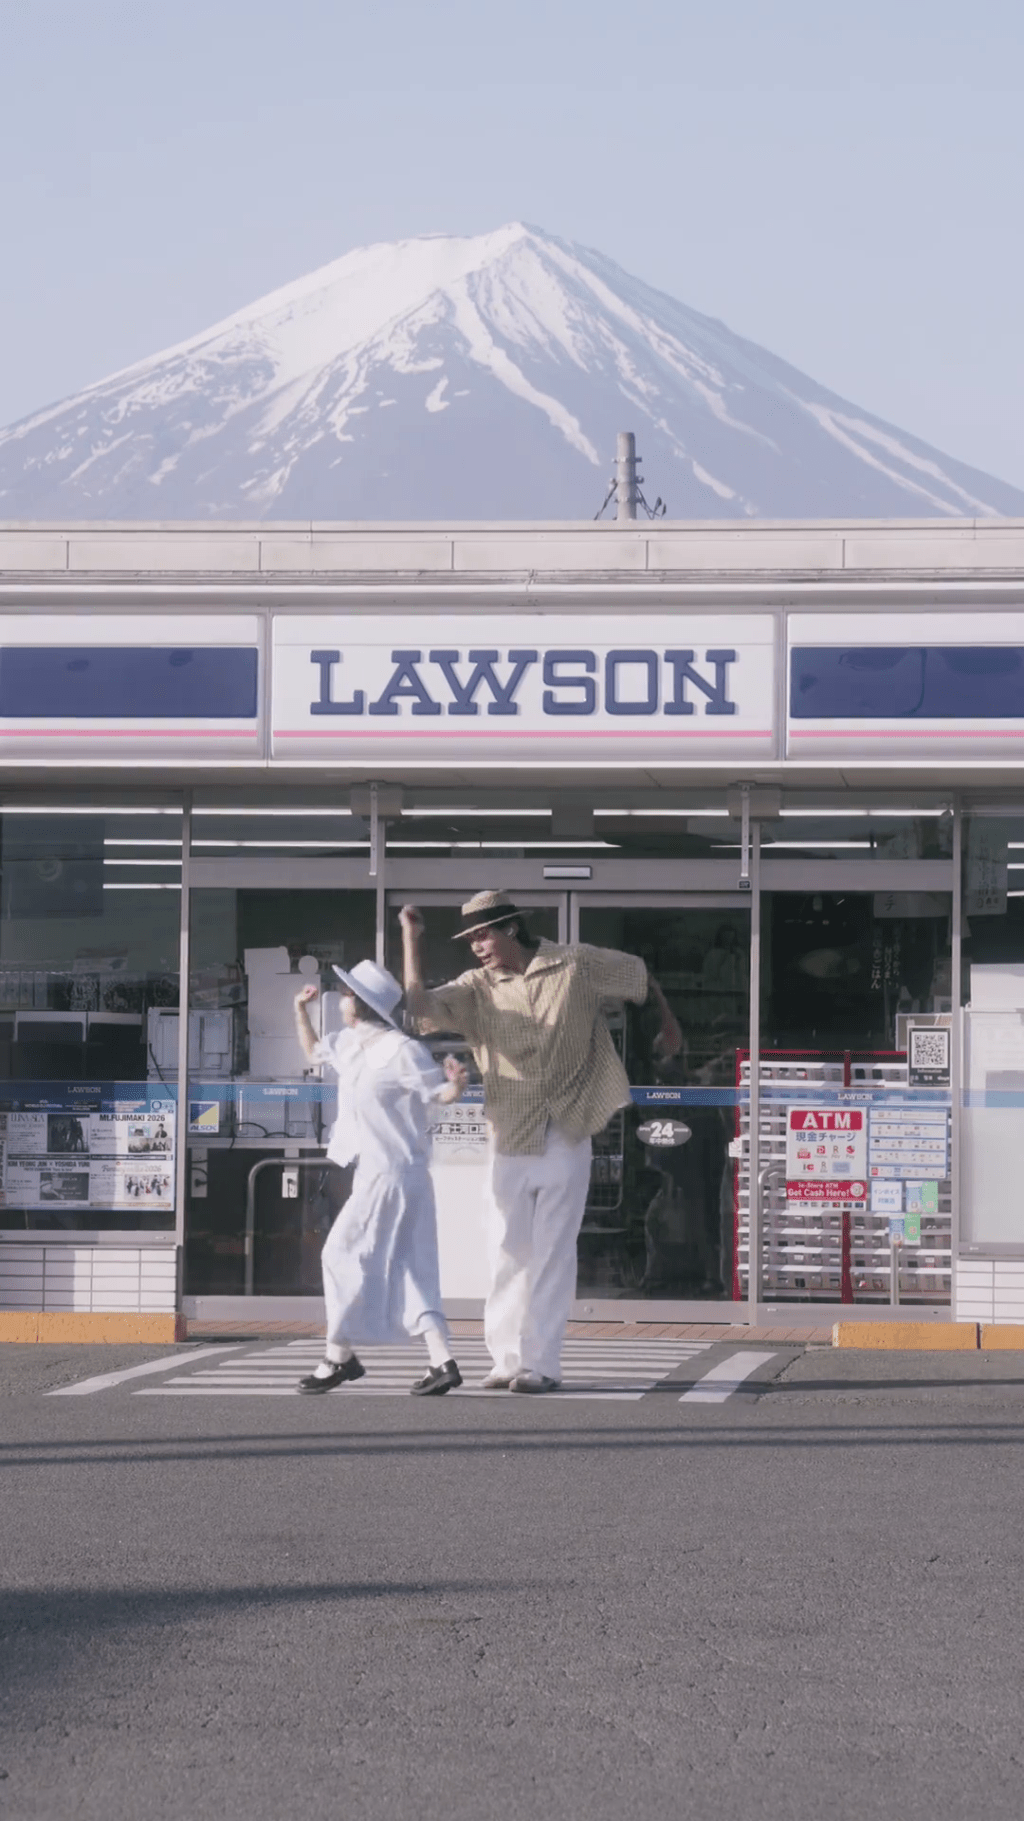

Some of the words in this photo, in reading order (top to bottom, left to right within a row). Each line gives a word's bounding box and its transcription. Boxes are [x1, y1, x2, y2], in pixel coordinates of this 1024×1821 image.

[310, 649, 736, 715] LAWSON
[67, 1086, 101, 1094] LAWSON
[263, 1088, 299, 1096] LAWSON
[837, 1093, 873, 1101] LAWSON
[147, 1114, 166, 1122] 2026
[802, 1112, 851, 1129] ATM
[650, 1121, 674, 1138] 24
[796, 1131, 856, 1142] 現金チャージ
[788, 1188, 802, 1196] Get
[804, 1188, 825, 1196] Cash
[826, 1188, 850, 1197] Here!
